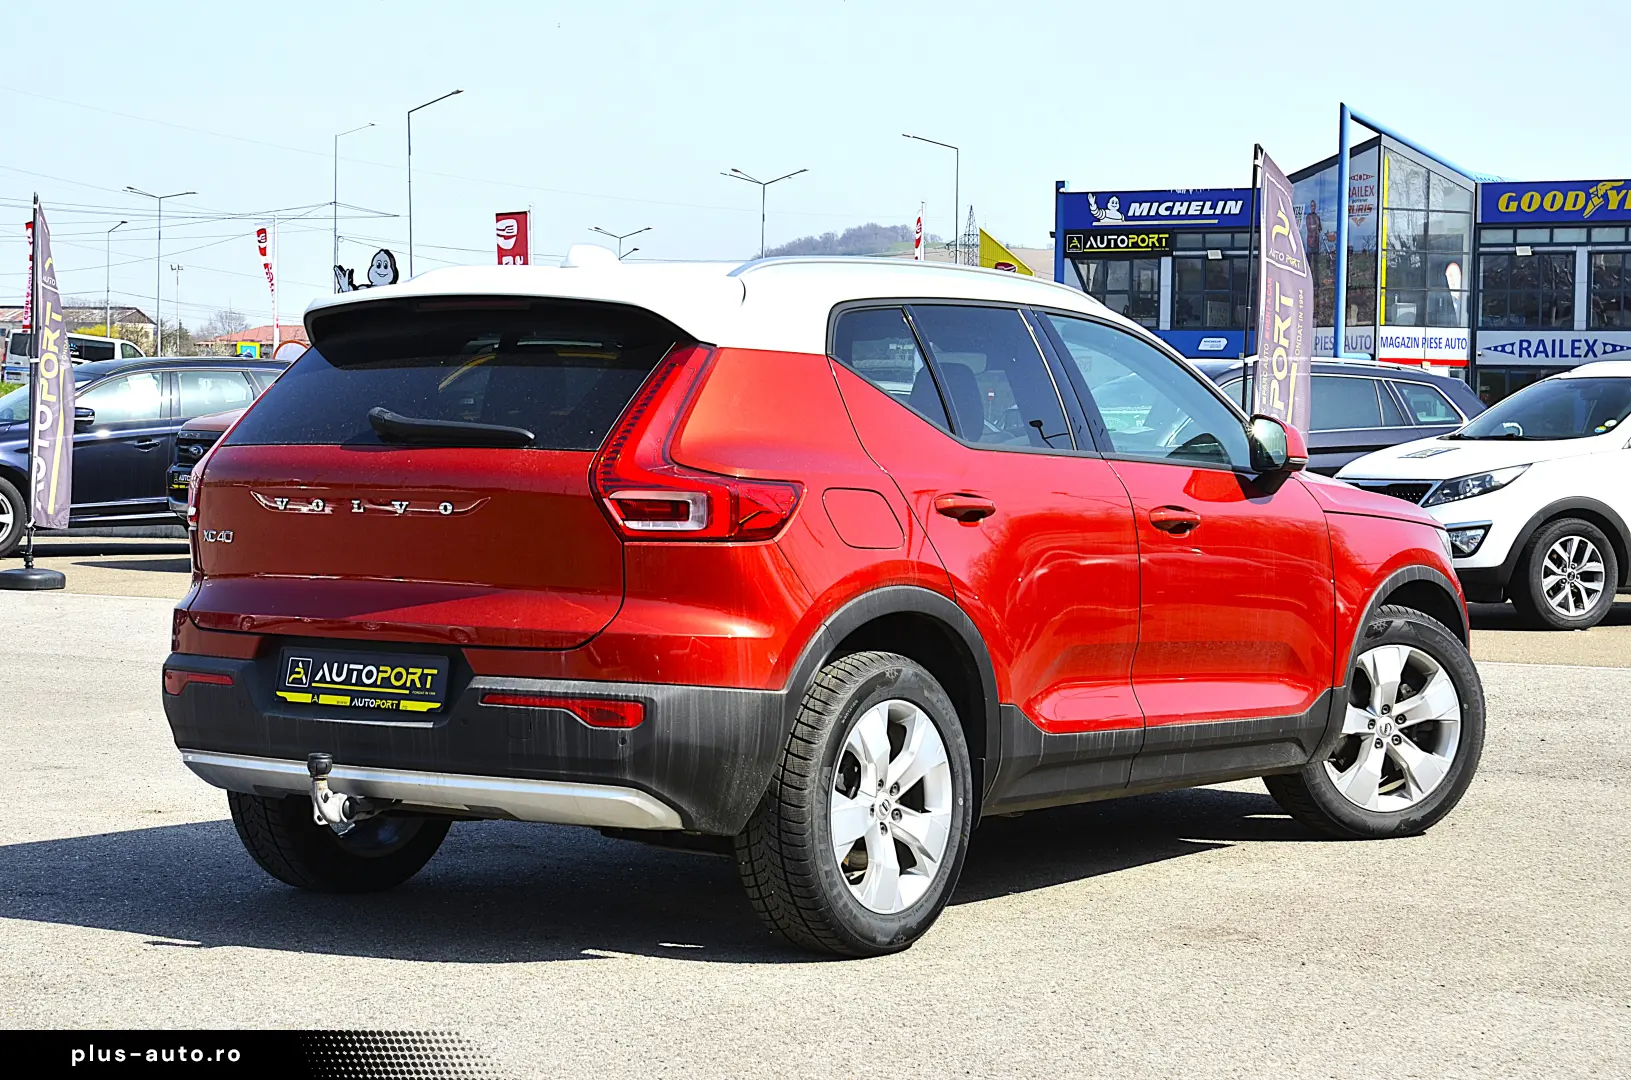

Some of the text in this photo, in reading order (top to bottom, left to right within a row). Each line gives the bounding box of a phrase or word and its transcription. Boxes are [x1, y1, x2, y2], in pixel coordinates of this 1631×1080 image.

[1127, 200, 1243, 217] MICHELIN
[1085, 233, 1169, 249] AUTOPORT
[1270, 281, 1294, 419] PORT
[1344, 335, 1372, 351] AUTO
[1380, 336, 1468, 350] MAGAZIN PIESE AUTO
[1518, 339, 1599, 358] RAILEX
[274, 497, 453, 515] VOLVO
[203, 529, 234, 544] XC40
[315, 661, 438, 689] AUTOPORT
[351, 698, 398, 709] AUTOPORT
